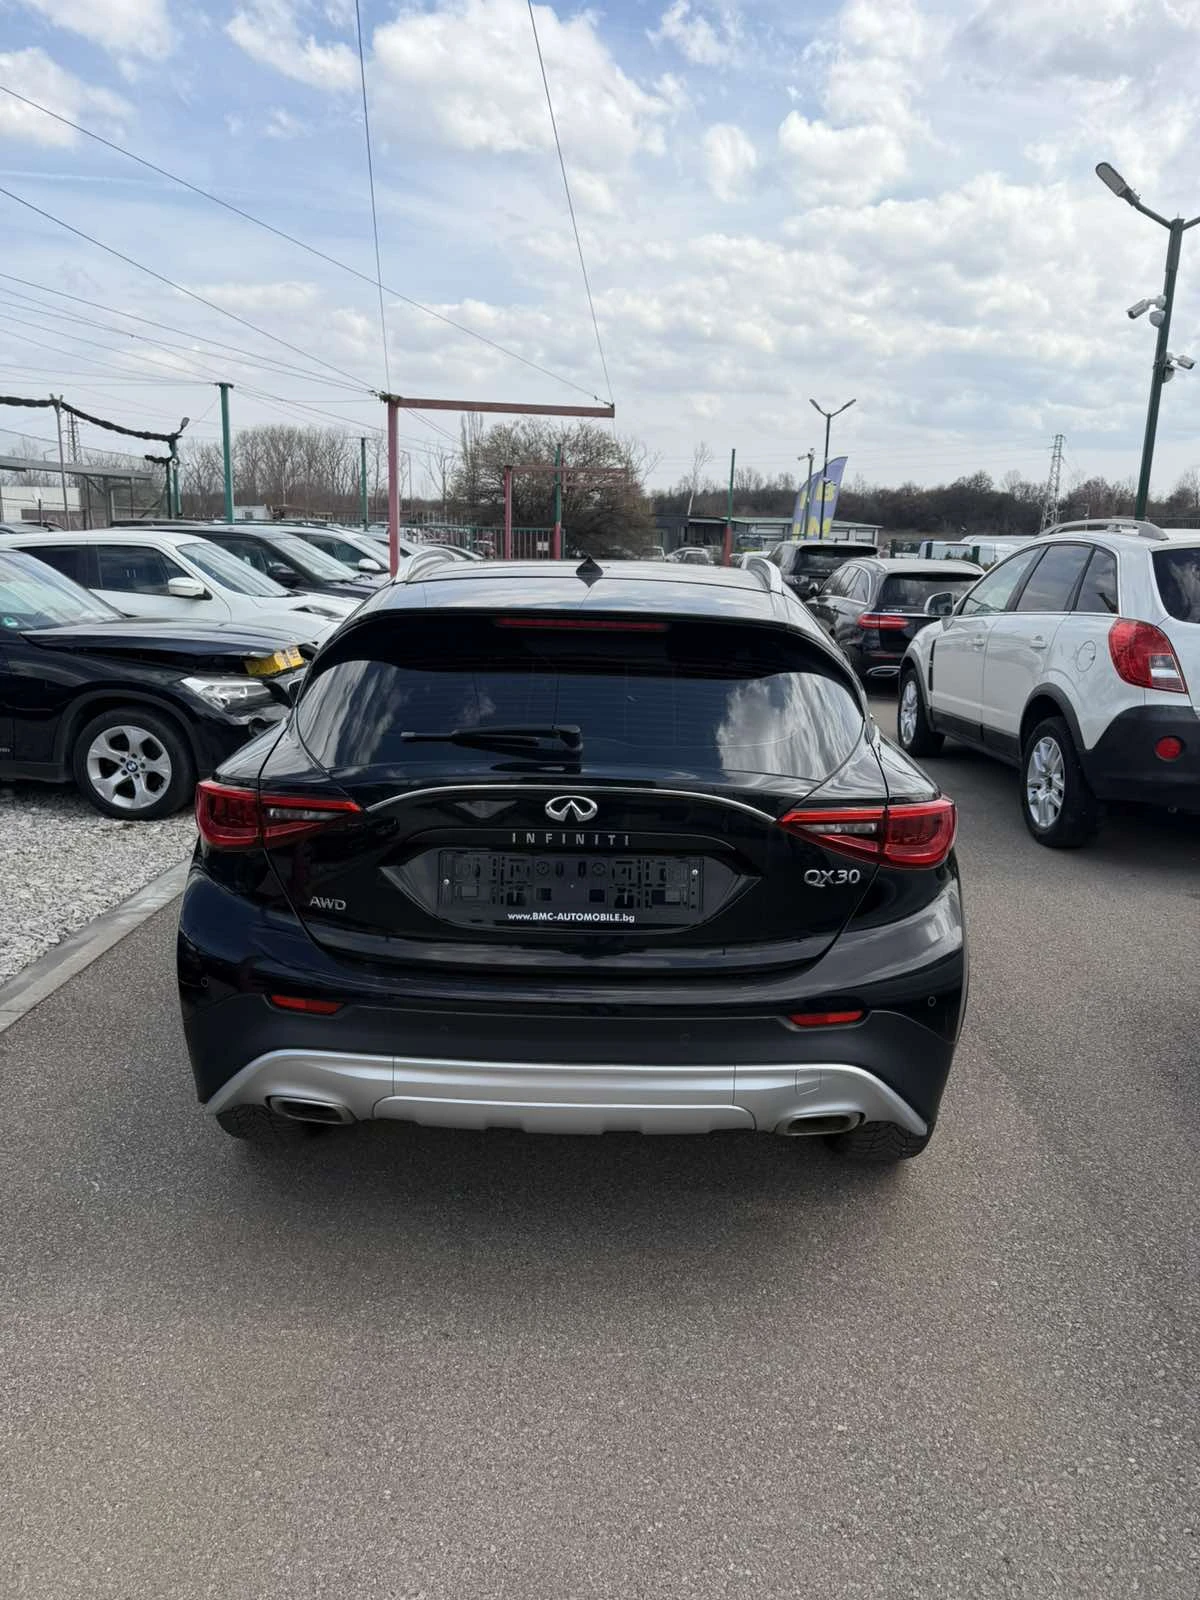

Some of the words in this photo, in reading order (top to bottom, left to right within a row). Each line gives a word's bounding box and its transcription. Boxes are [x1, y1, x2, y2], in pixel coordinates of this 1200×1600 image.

[511, 832, 629, 846] INFINITI
[804, 869, 861, 888] QX30
[309, 896, 347, 910] AWD
[507, 912, 635, 923] www.BMC-AUTOMOBILE.bg
